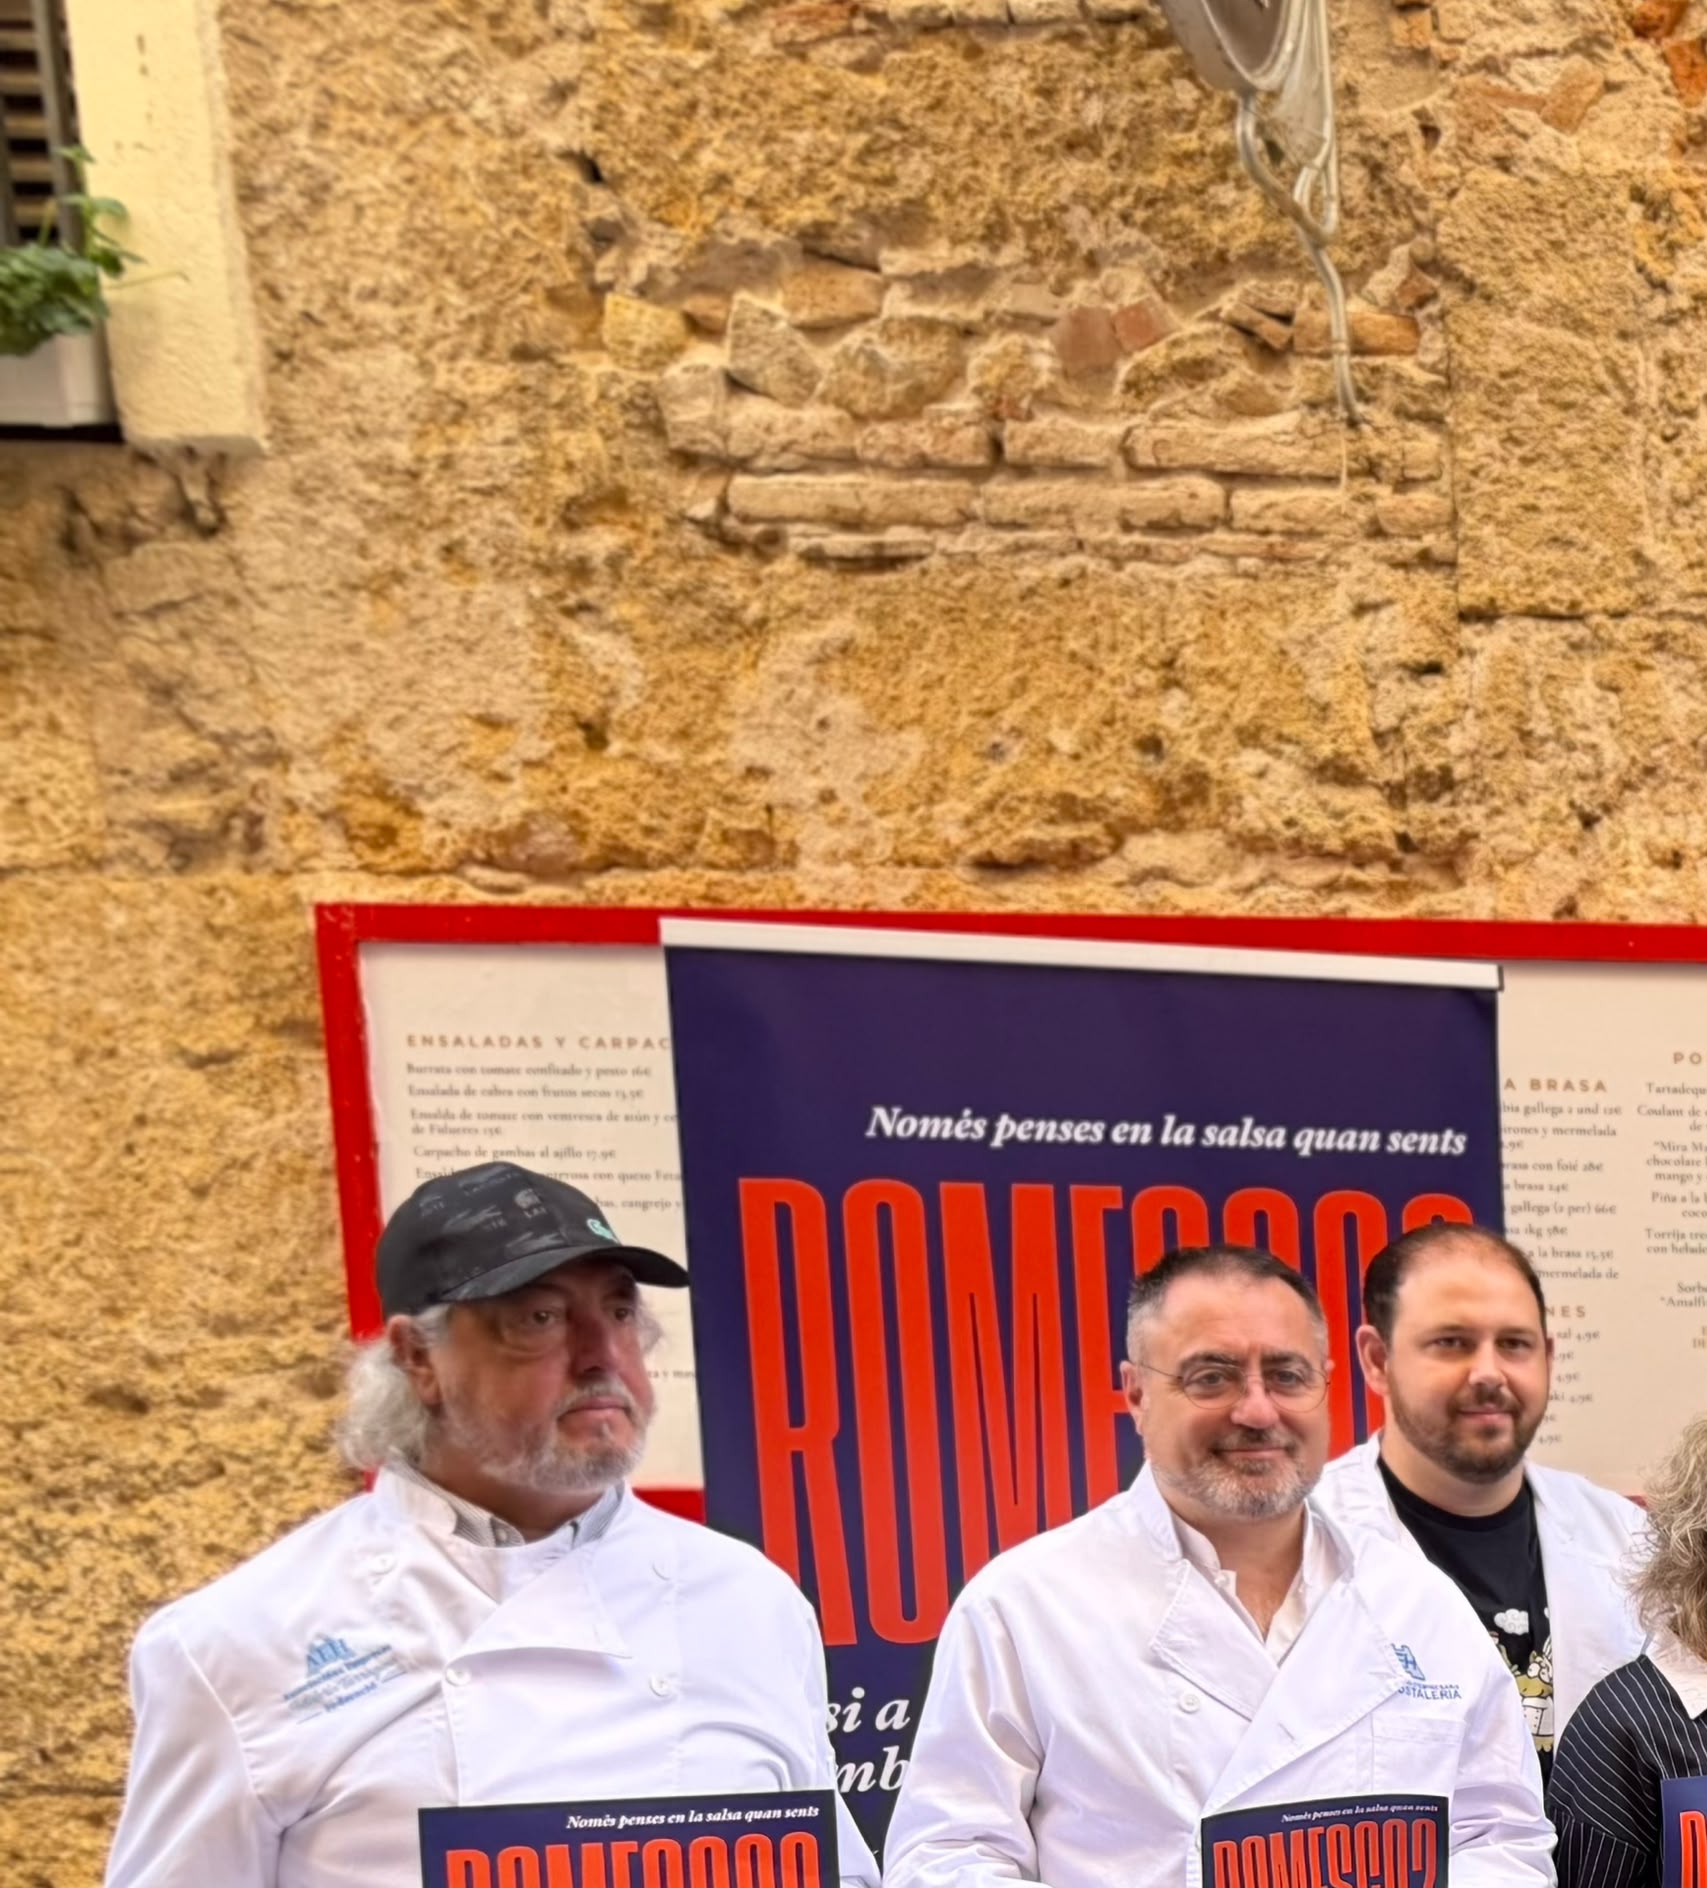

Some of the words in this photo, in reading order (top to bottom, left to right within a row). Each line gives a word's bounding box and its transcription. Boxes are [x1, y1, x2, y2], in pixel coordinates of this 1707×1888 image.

[408, 1035, 542, 1048] ENSALADAS
[555, 1038, 566, 1048] Y
[579, 1038, 671, 1050] CARPAC
[1531, 1078, 1607, 1093] BRASA
[1637, 1105, 1684, 1117] Coulant
[1688, 1106, 1701, 1117] de
[866, 1106, 987, 1141] Només
[992, 1113, 1105, 1148] penses
[1110, 1120, 1152, 1145] en
[1160, 1114, 1195, 1146] la
[1200, 1117, 1286, 1150] salsa
[1292, 1126, 1380, 1157] quan
[1385, 1128, 1468, 1155] sents
[875, 1696, 910, 1732] a
[837, 1747, 909, 1793] mb
